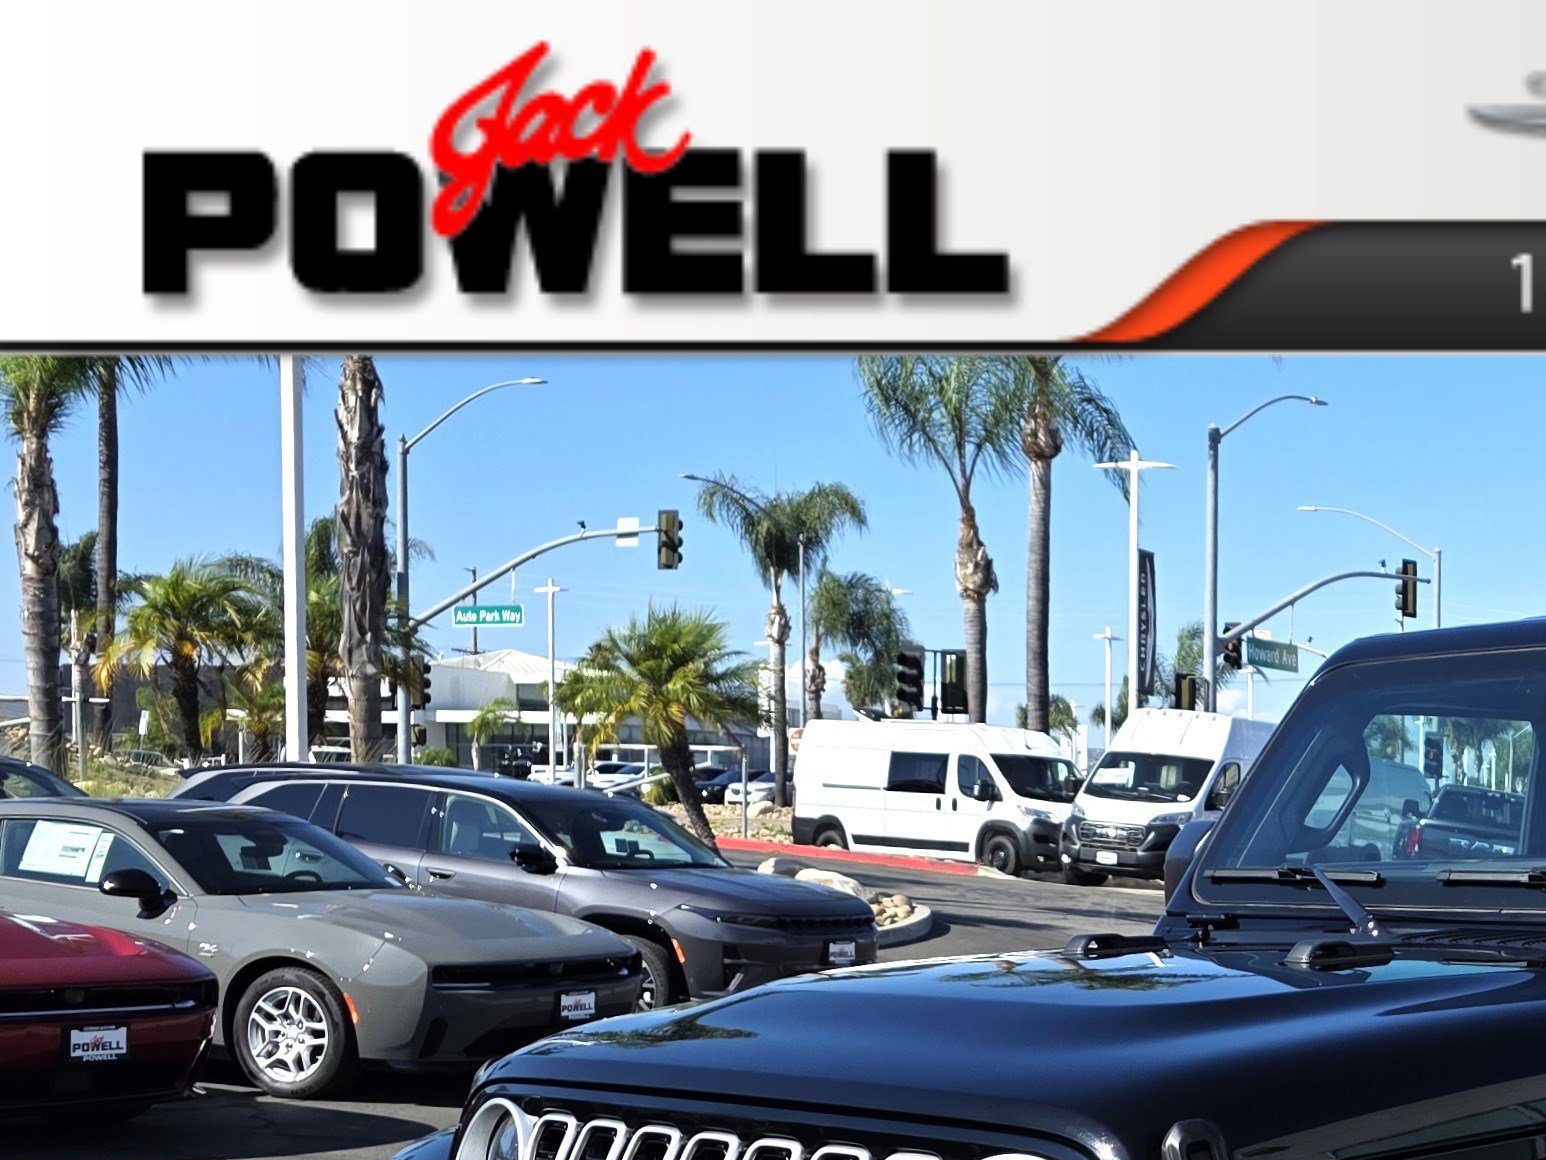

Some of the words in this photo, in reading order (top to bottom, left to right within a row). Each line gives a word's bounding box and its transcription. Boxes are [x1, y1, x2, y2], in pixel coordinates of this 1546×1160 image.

[456, 610, 477, 622] Auto
[480, 609, 500, 622] Park
[501, 609, 521, 624] Way
[1248, 643, 1280, 664] Howard
[1282, 649, 1297, 667] Ave
[72, 1040, 124, 1053] POWELL
